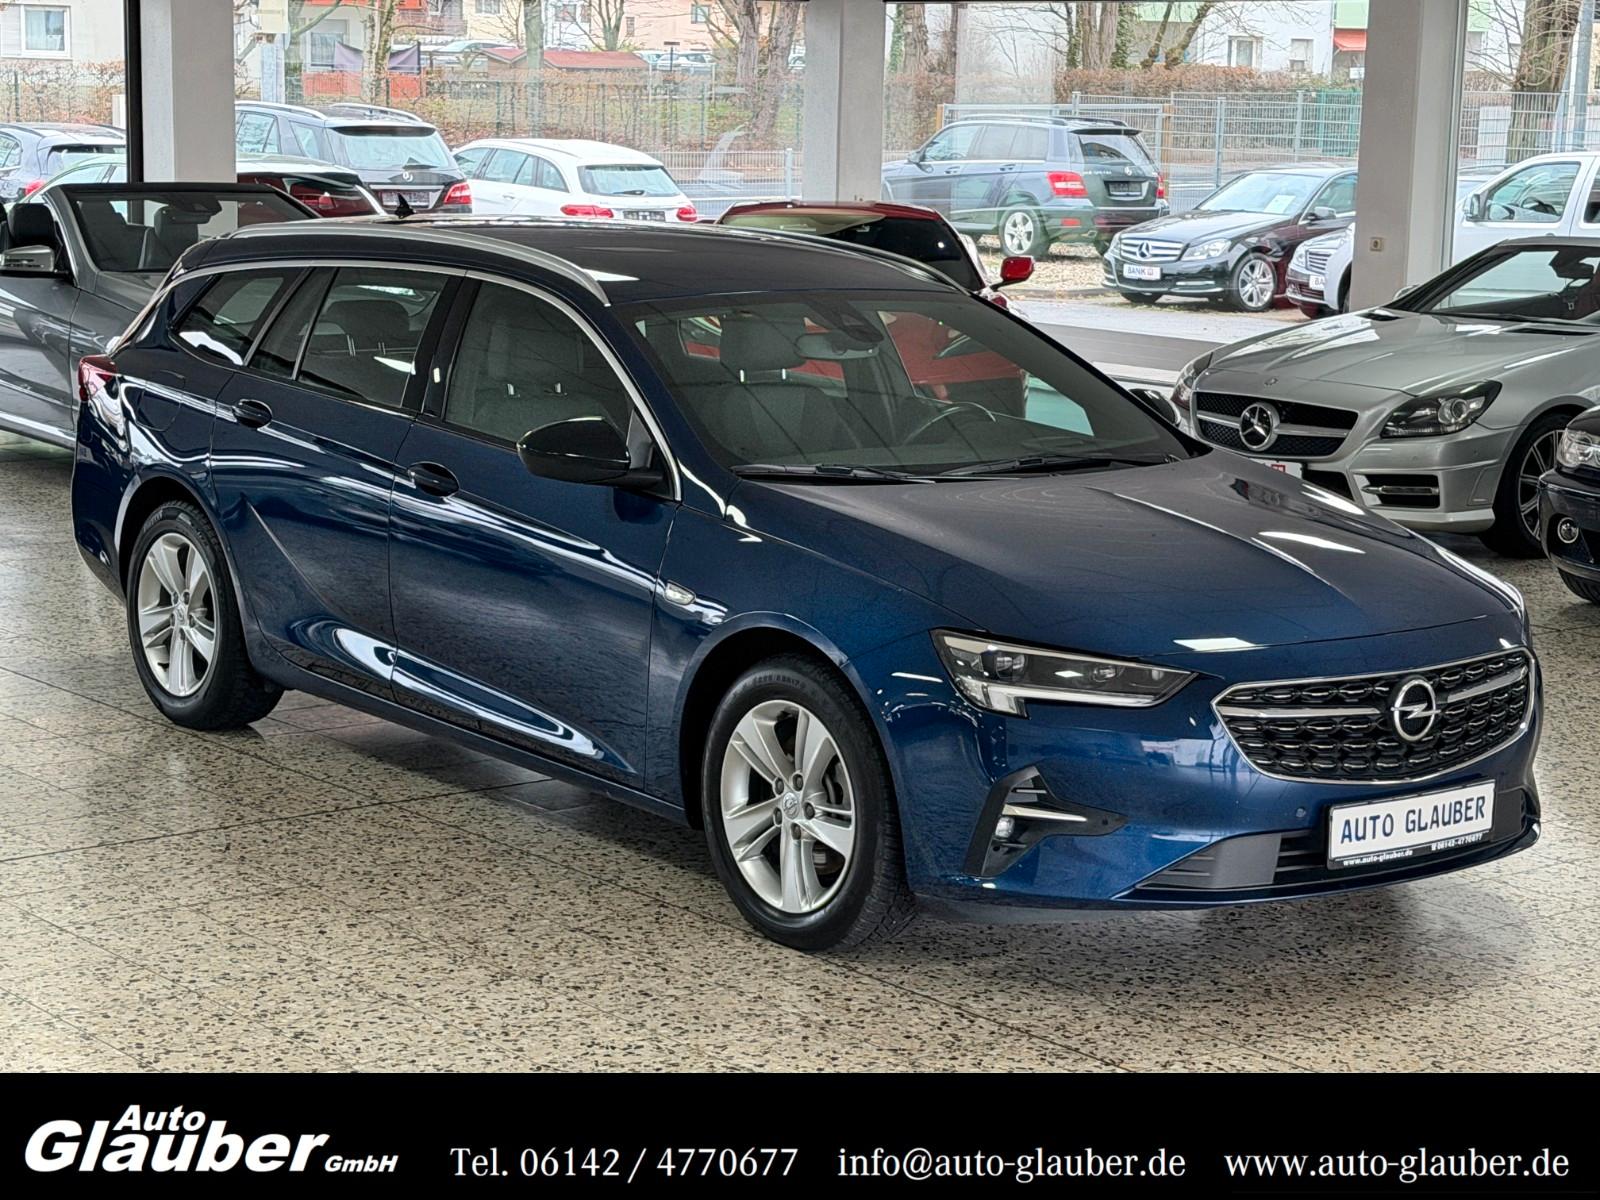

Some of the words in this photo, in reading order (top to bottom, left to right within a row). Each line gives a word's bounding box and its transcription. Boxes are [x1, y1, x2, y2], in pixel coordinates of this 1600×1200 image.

[1340, 813, 1394, 844] AUTO
[1405, 796, 1485, 833] GLAUBER
[1343, 849, 1413, 866] www.auto-glauber.de
